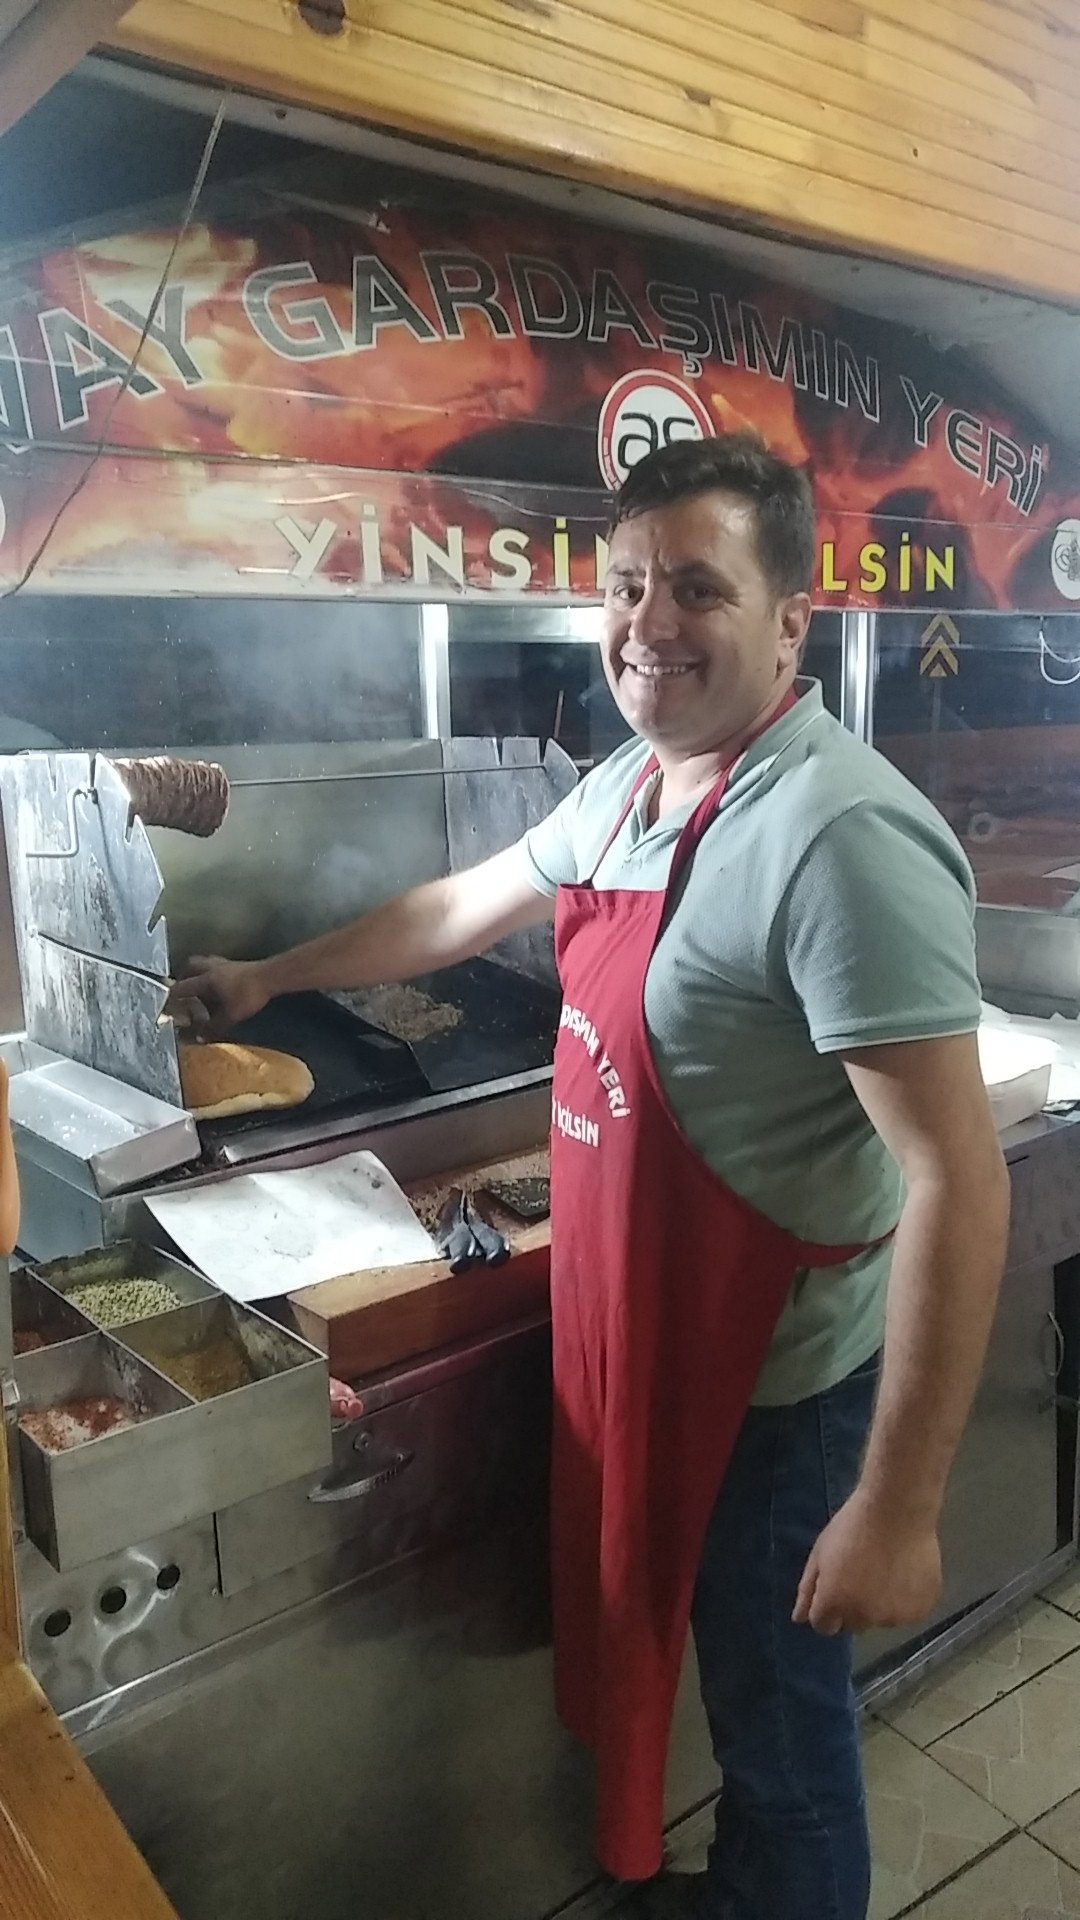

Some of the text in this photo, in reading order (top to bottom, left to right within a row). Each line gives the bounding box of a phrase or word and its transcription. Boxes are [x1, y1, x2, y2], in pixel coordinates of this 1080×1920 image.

[242, 250, 881, 424] GARDAŞIMIN
[899, 374, 1044, 517] YERİ
[597, 1051, 631, 1118] YERİ
